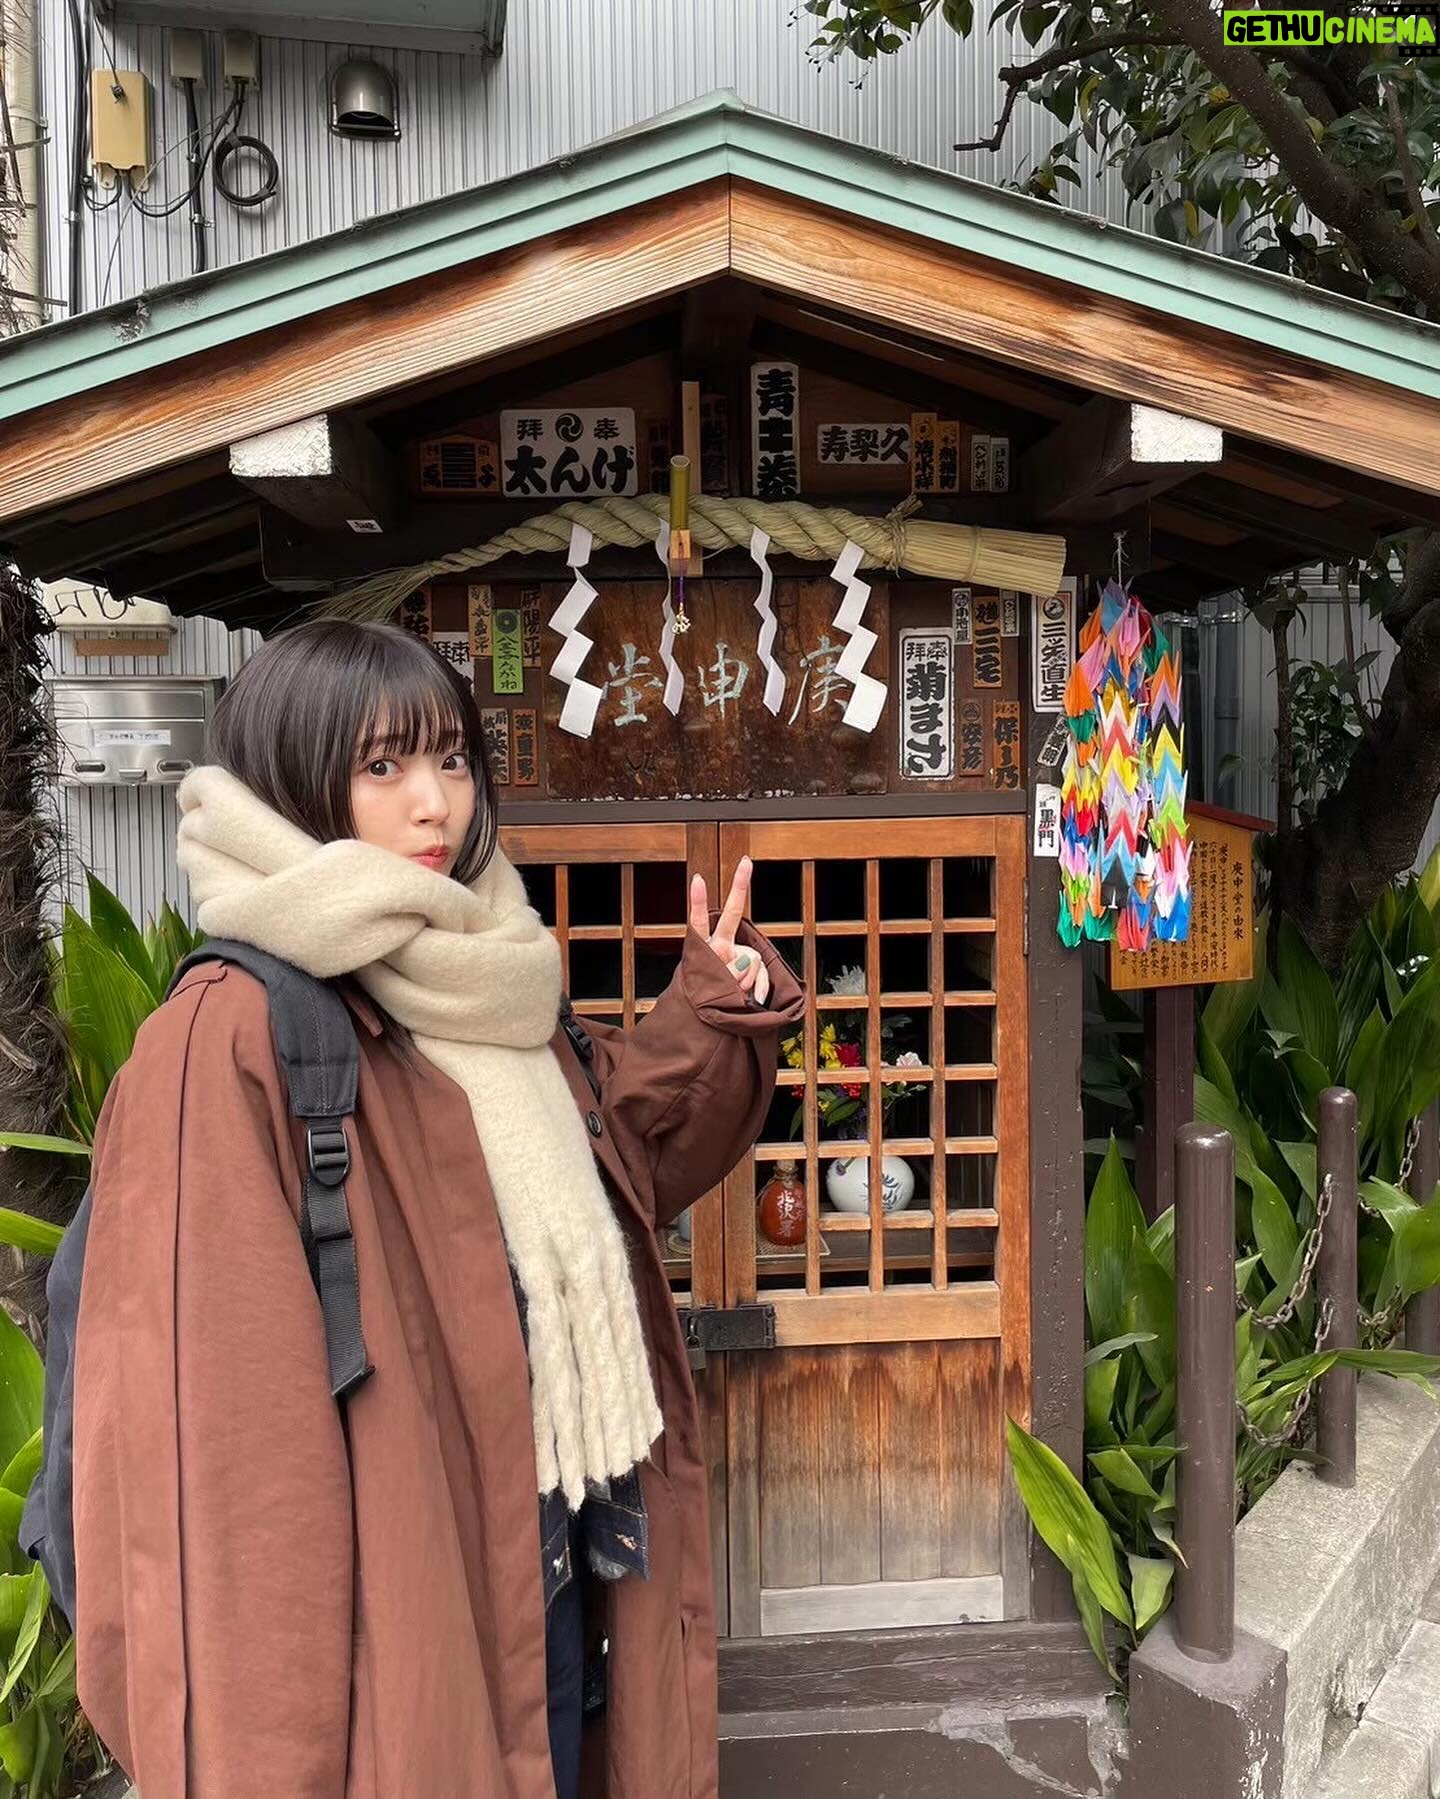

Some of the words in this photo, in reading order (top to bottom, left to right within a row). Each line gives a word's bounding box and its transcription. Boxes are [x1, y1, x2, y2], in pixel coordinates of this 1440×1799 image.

[906, 662, 947, 773] 菊まさ
[1232, 861, 1245, 941] 庚申堂の由来
